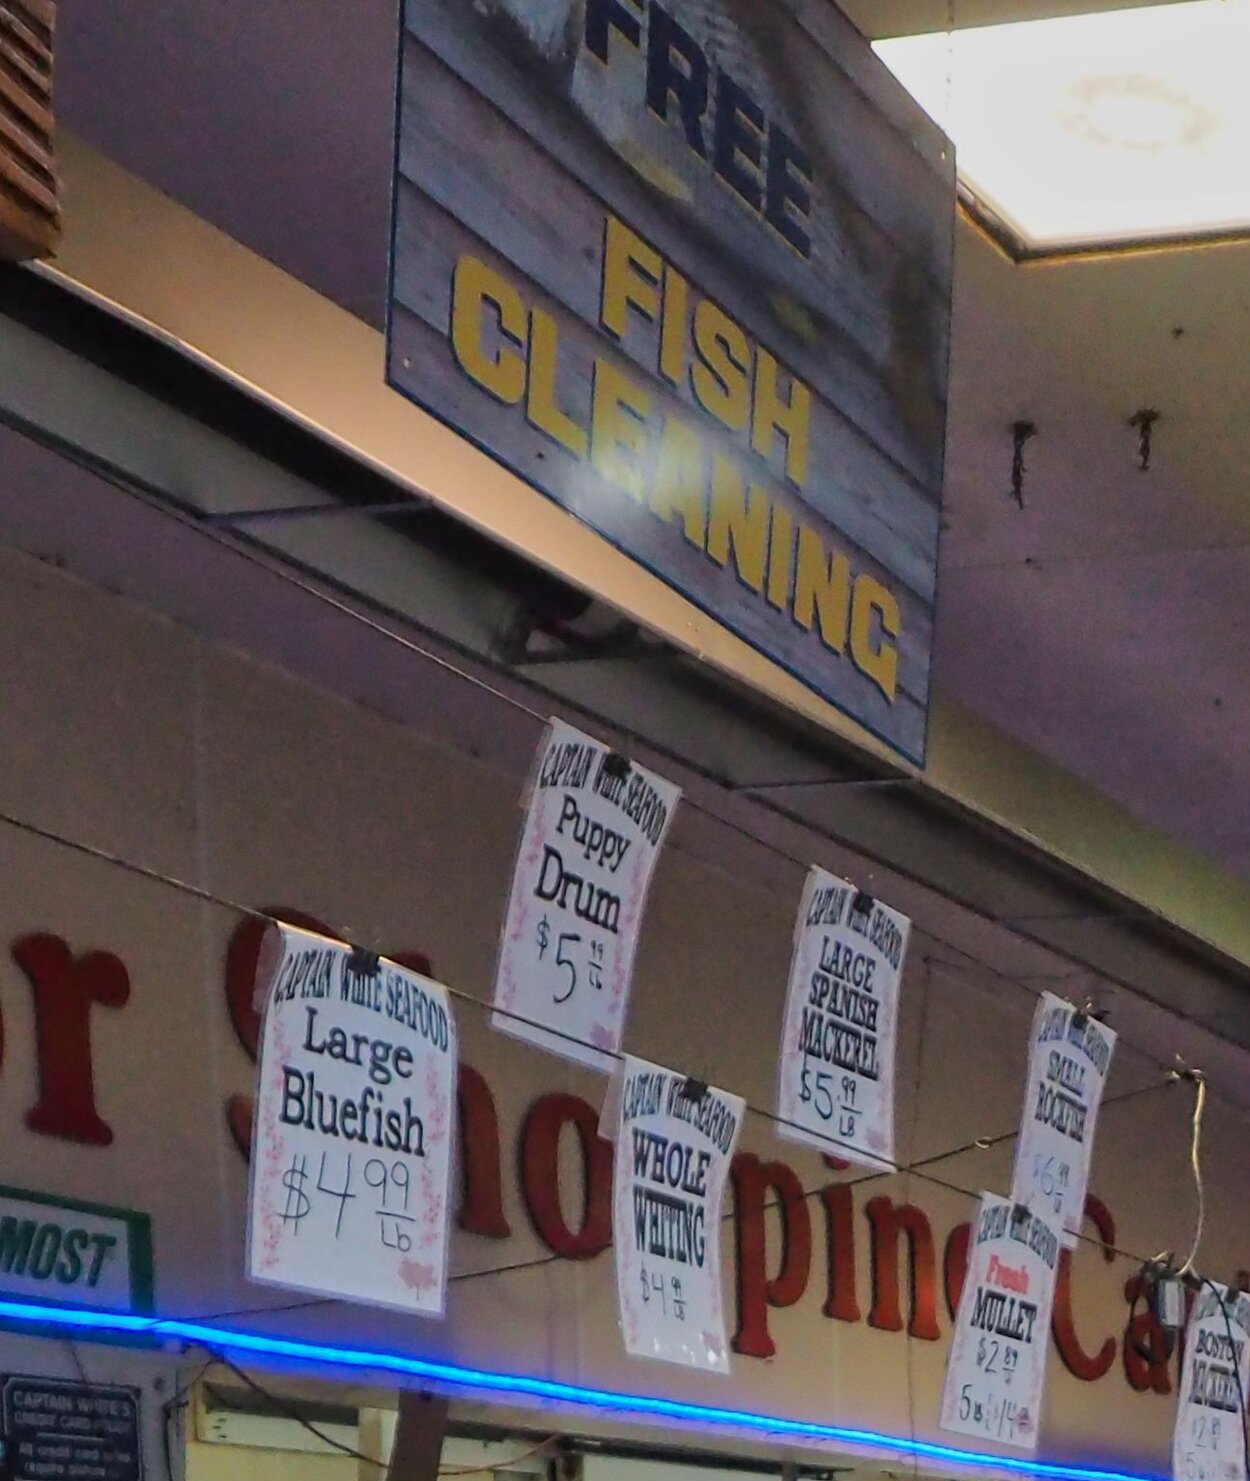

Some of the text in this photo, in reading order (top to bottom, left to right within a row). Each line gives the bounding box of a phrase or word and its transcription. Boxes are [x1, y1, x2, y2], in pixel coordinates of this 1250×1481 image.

[585, 0, 813, 258] FREE
[601, 215, 811, 488] FISH
[450, 254, 899, 706] CLEANING
[540, 743, 597, 791] CAPTAIN
[619, 770, 669, 847] SEAFOOD
[556, 793, 632, 873] Puppy
[533, 844, 622, 934] Drum
[273, 947, 449, 1054] CAPTAIN WHITE SEAFOOD
[808, 971, 881, 1033] SPANISH
[819, 935, 878, 994] LARGE
[303, 1004, 414, 1085] Large
[798, 1005, 881, 1082] MACKEREL
[279, 1065, 426, 1158] Bluefish
[622, 1072, 667, 1123] CAPTAIN
[631, 1126, 711, 1198] WHOLE
[632, 1184, 706, 1269] WHITING
[970, 1285, 1038, 1345] MULLET
